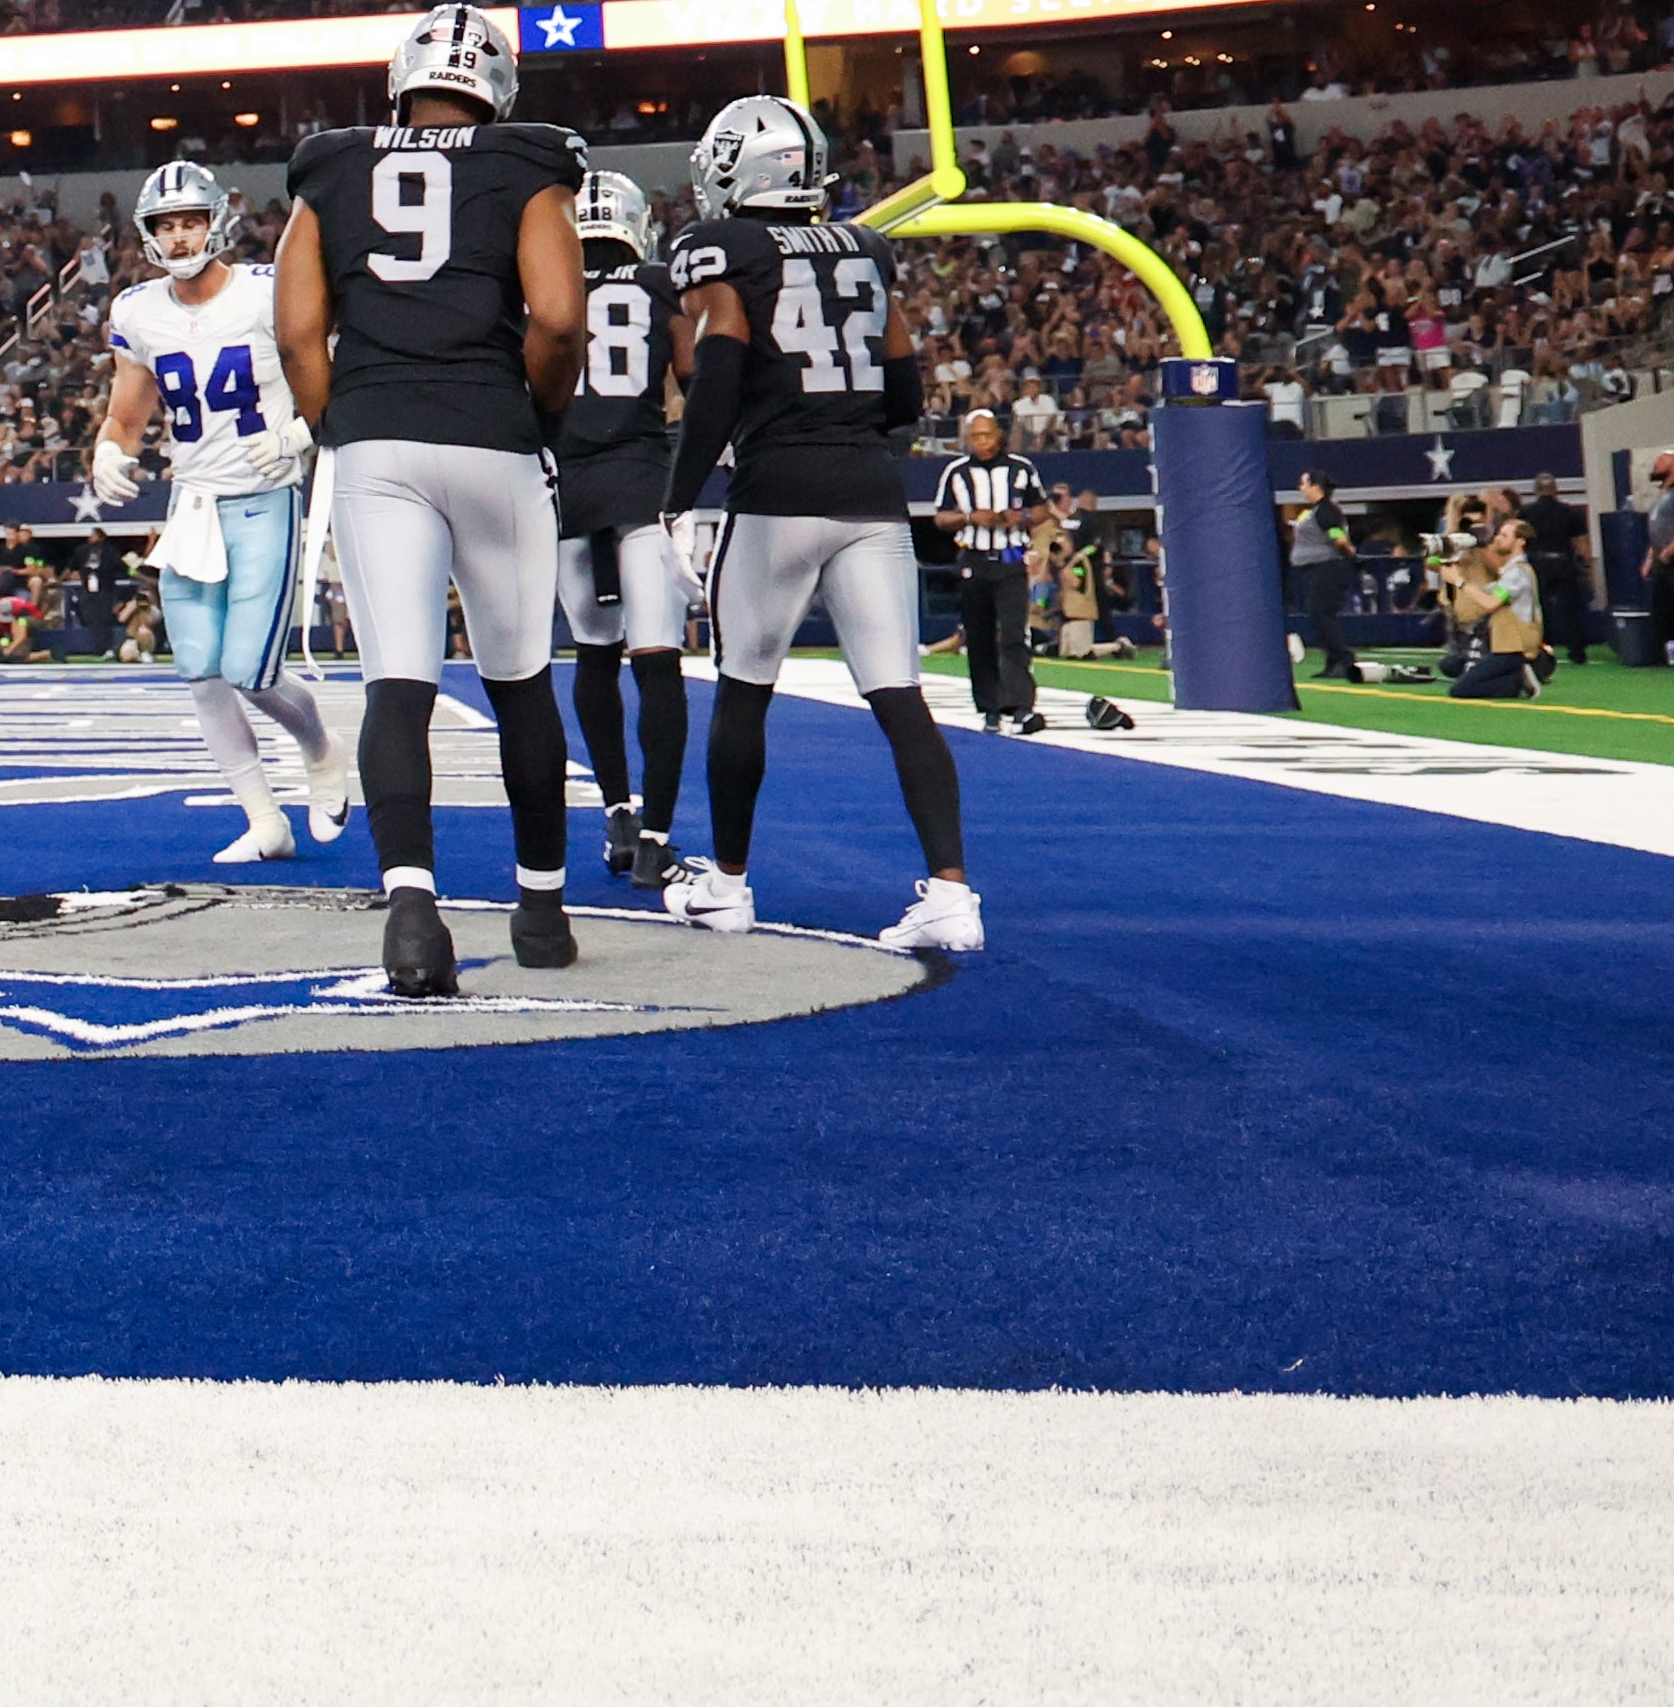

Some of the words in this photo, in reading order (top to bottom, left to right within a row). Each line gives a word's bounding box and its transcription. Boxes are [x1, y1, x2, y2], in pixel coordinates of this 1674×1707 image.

[463, 51, 477, 69] 9
[428, 70, 478, 89] RAIDERS
[373, 126, 477, 150] WILSON
[365, 151, 452, 283] 9
[766, 226, 834, 254] SMITH
[605, 265, 639, 281] JR
[670, 246, 727, 291] 42
[576, 284, 652, 398] 8
[771, 258, 890, 393] 42
[155, 345, 267, 443] 84
